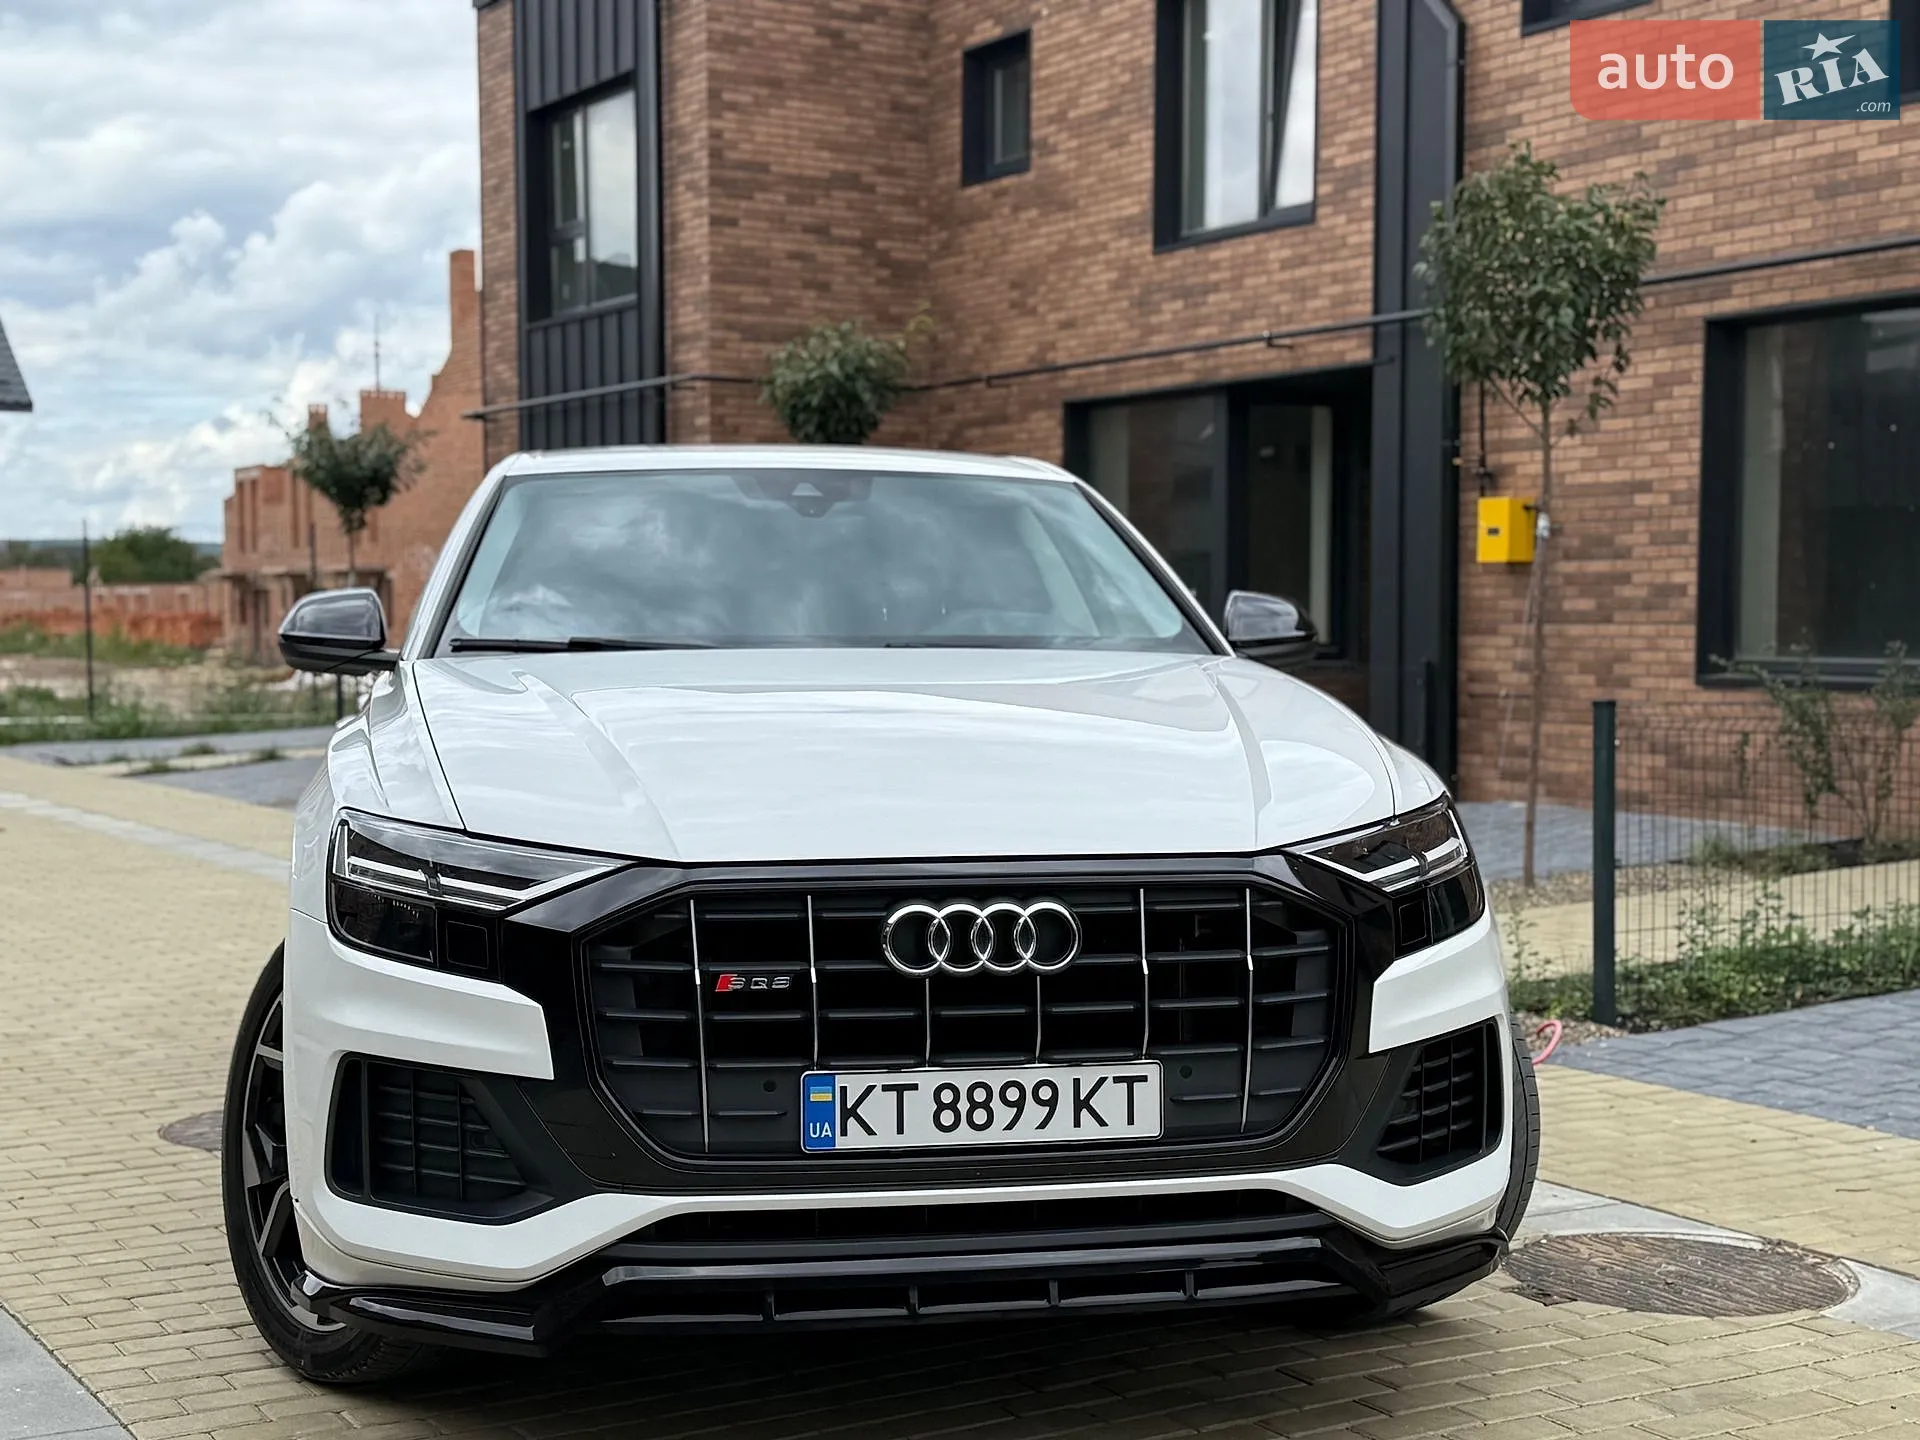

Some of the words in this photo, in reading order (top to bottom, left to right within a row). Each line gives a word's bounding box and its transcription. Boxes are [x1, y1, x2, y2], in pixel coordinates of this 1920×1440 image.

[839, 1083, 919, 1137] KT
[932, 1079, 1060, 1133] 8899
[1072, 1074, 1149, 1129] KT
[809, 1122, 832, 1138] UA
